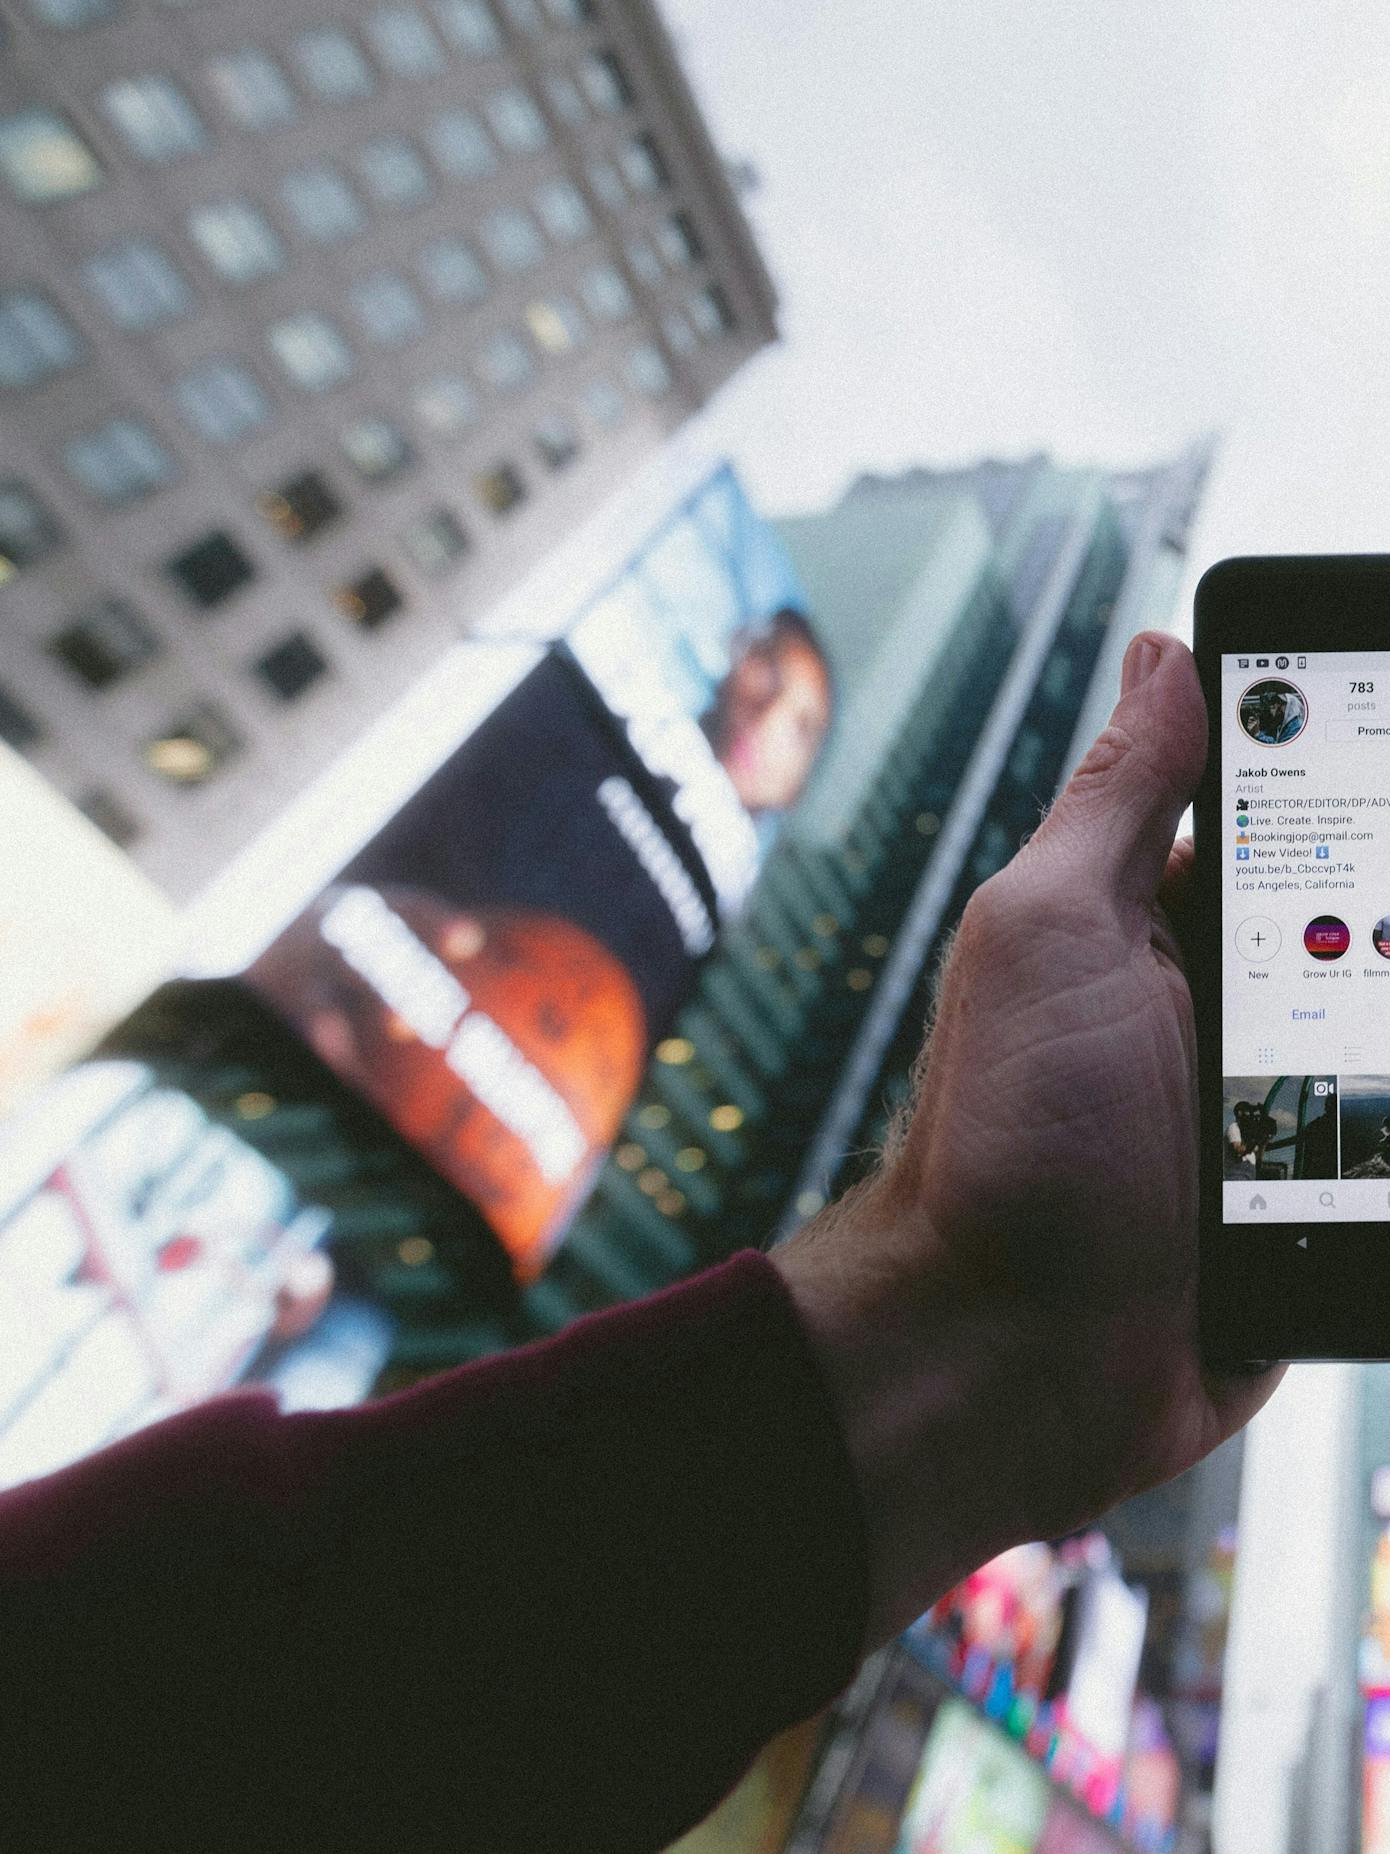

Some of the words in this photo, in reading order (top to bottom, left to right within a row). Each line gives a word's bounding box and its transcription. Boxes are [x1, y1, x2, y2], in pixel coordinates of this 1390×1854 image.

[1349, 682, 1374, 693] 783
[1347, 702, 1376, 712] posts
[1235, 768, 1268, 778] Jakob
[1270, 768, 1306, 777] Owens
[1235, 784, 1264, 793] Artist
[1250, 816, 1274, 826] Live.
[1276, 816, 1314, 825] Create.
[1317, 815, 1355, 827] Inspire.
[1250, 831, 1374, 844] Bookingjop@gmail.com
[1253, 848, 1276, 858] New
[1279, 848, 1312, 858] Video!
[1235, 881, 1255, 890] Los
[1257, 880, 1302, 893] Angeles,
[1304, 879, 1355, 890] California
[1248, 970, 1269, 980] New
[1303, 970, 1327, 980] Grow
[1329, 969, 1340, 979] Ur
[1342, 968, 1352, 979] IG
[1292, 1008, 1326, 1020] Email
